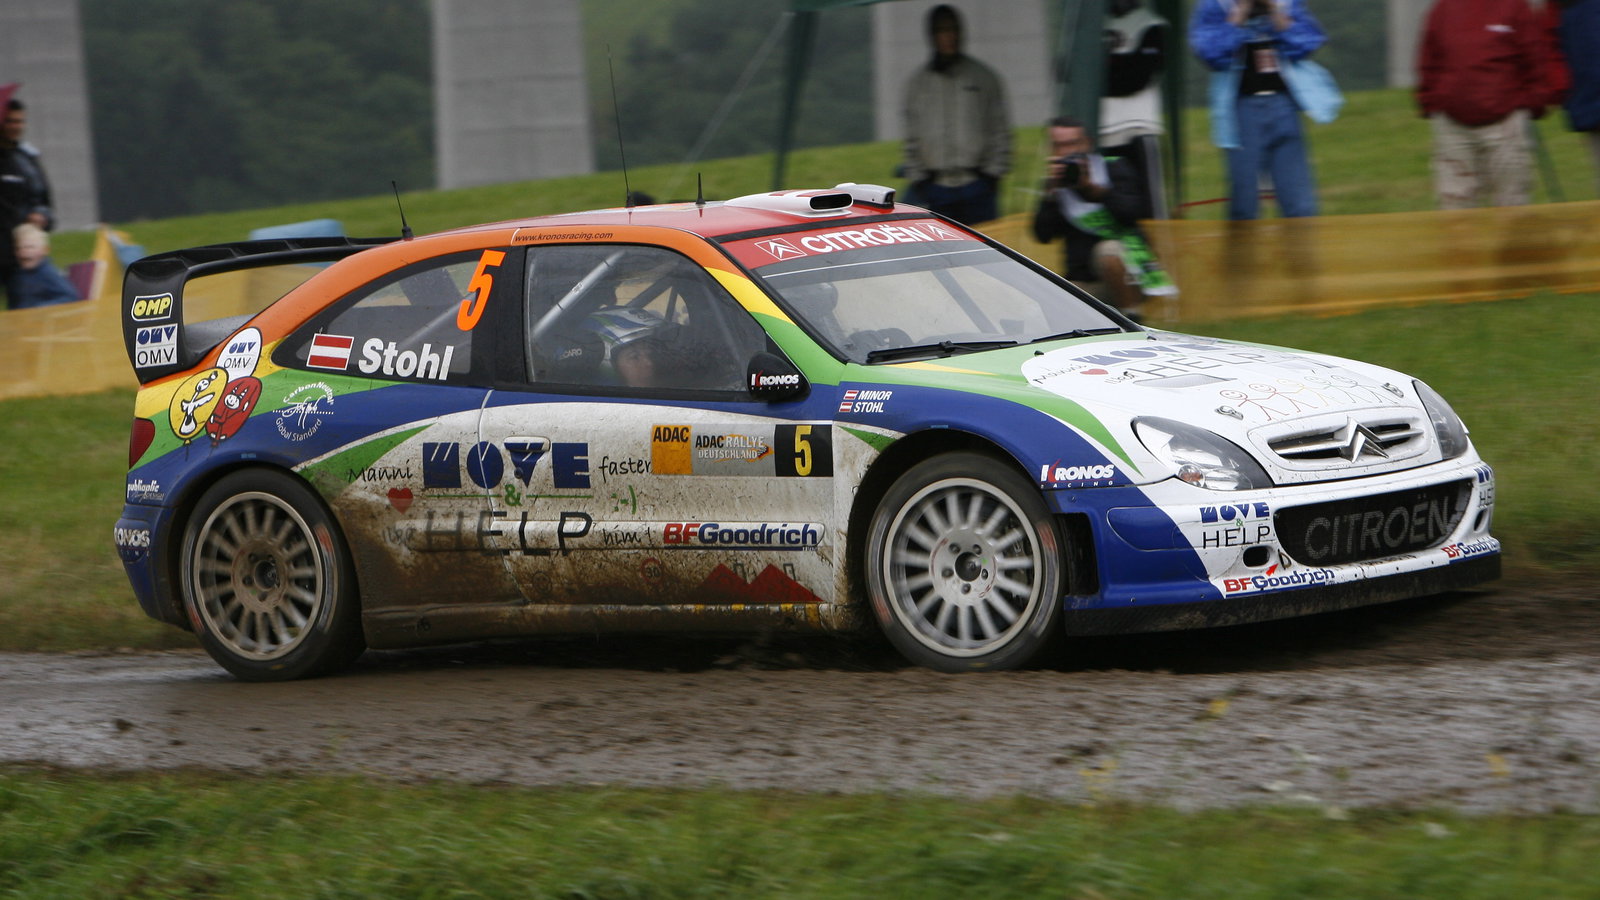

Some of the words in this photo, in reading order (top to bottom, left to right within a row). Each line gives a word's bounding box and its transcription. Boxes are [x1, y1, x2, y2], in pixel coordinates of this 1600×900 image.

[515, 232, 613, 242] www.kronosracing.com
[801, 225, 934, 253] CITROËN
[456, 249, 506, 331] 5
[133, 297, 171, 316] OMP
[137, 347, 174, 365] OMV
[223, 357, 251, 369] OMV
[358, 338, 454, 381] Stohl
[751, 370, 799, 387] KRONOS
[858, 390, 892, 401] MINOR
[854, 402, 884, 413] STOHL
[276, 417, 292, 439] Global
[291, 418, 322, 442] Standard
[653, 427, 689, 443] ADAC
[695, 435, 724, 449] ADAC
[726, 435, 765, 448] RALLYE
[794, 425, 813, 477] 5
[347, 459, 413, 483] Manni
[422, 441, 591, 489] MOVE
[599, 456, 652, 483] faster
[698, 450, 759, 459] DEUTSCHLAND
[1040, 459, 1114, 482] KRONOS
[505, 484, 522, 506] &
[1200, 502, 1270, 523] MOVE
[425, 510, 593, 556] HELP
[663, 523, 818, 545] BFGoodrich
[1202, 525, 1270, 549] HELP
[1305, 494, 1449, 560] CITROËN
[1223, 568, 1335, 592] BFGoodrich
